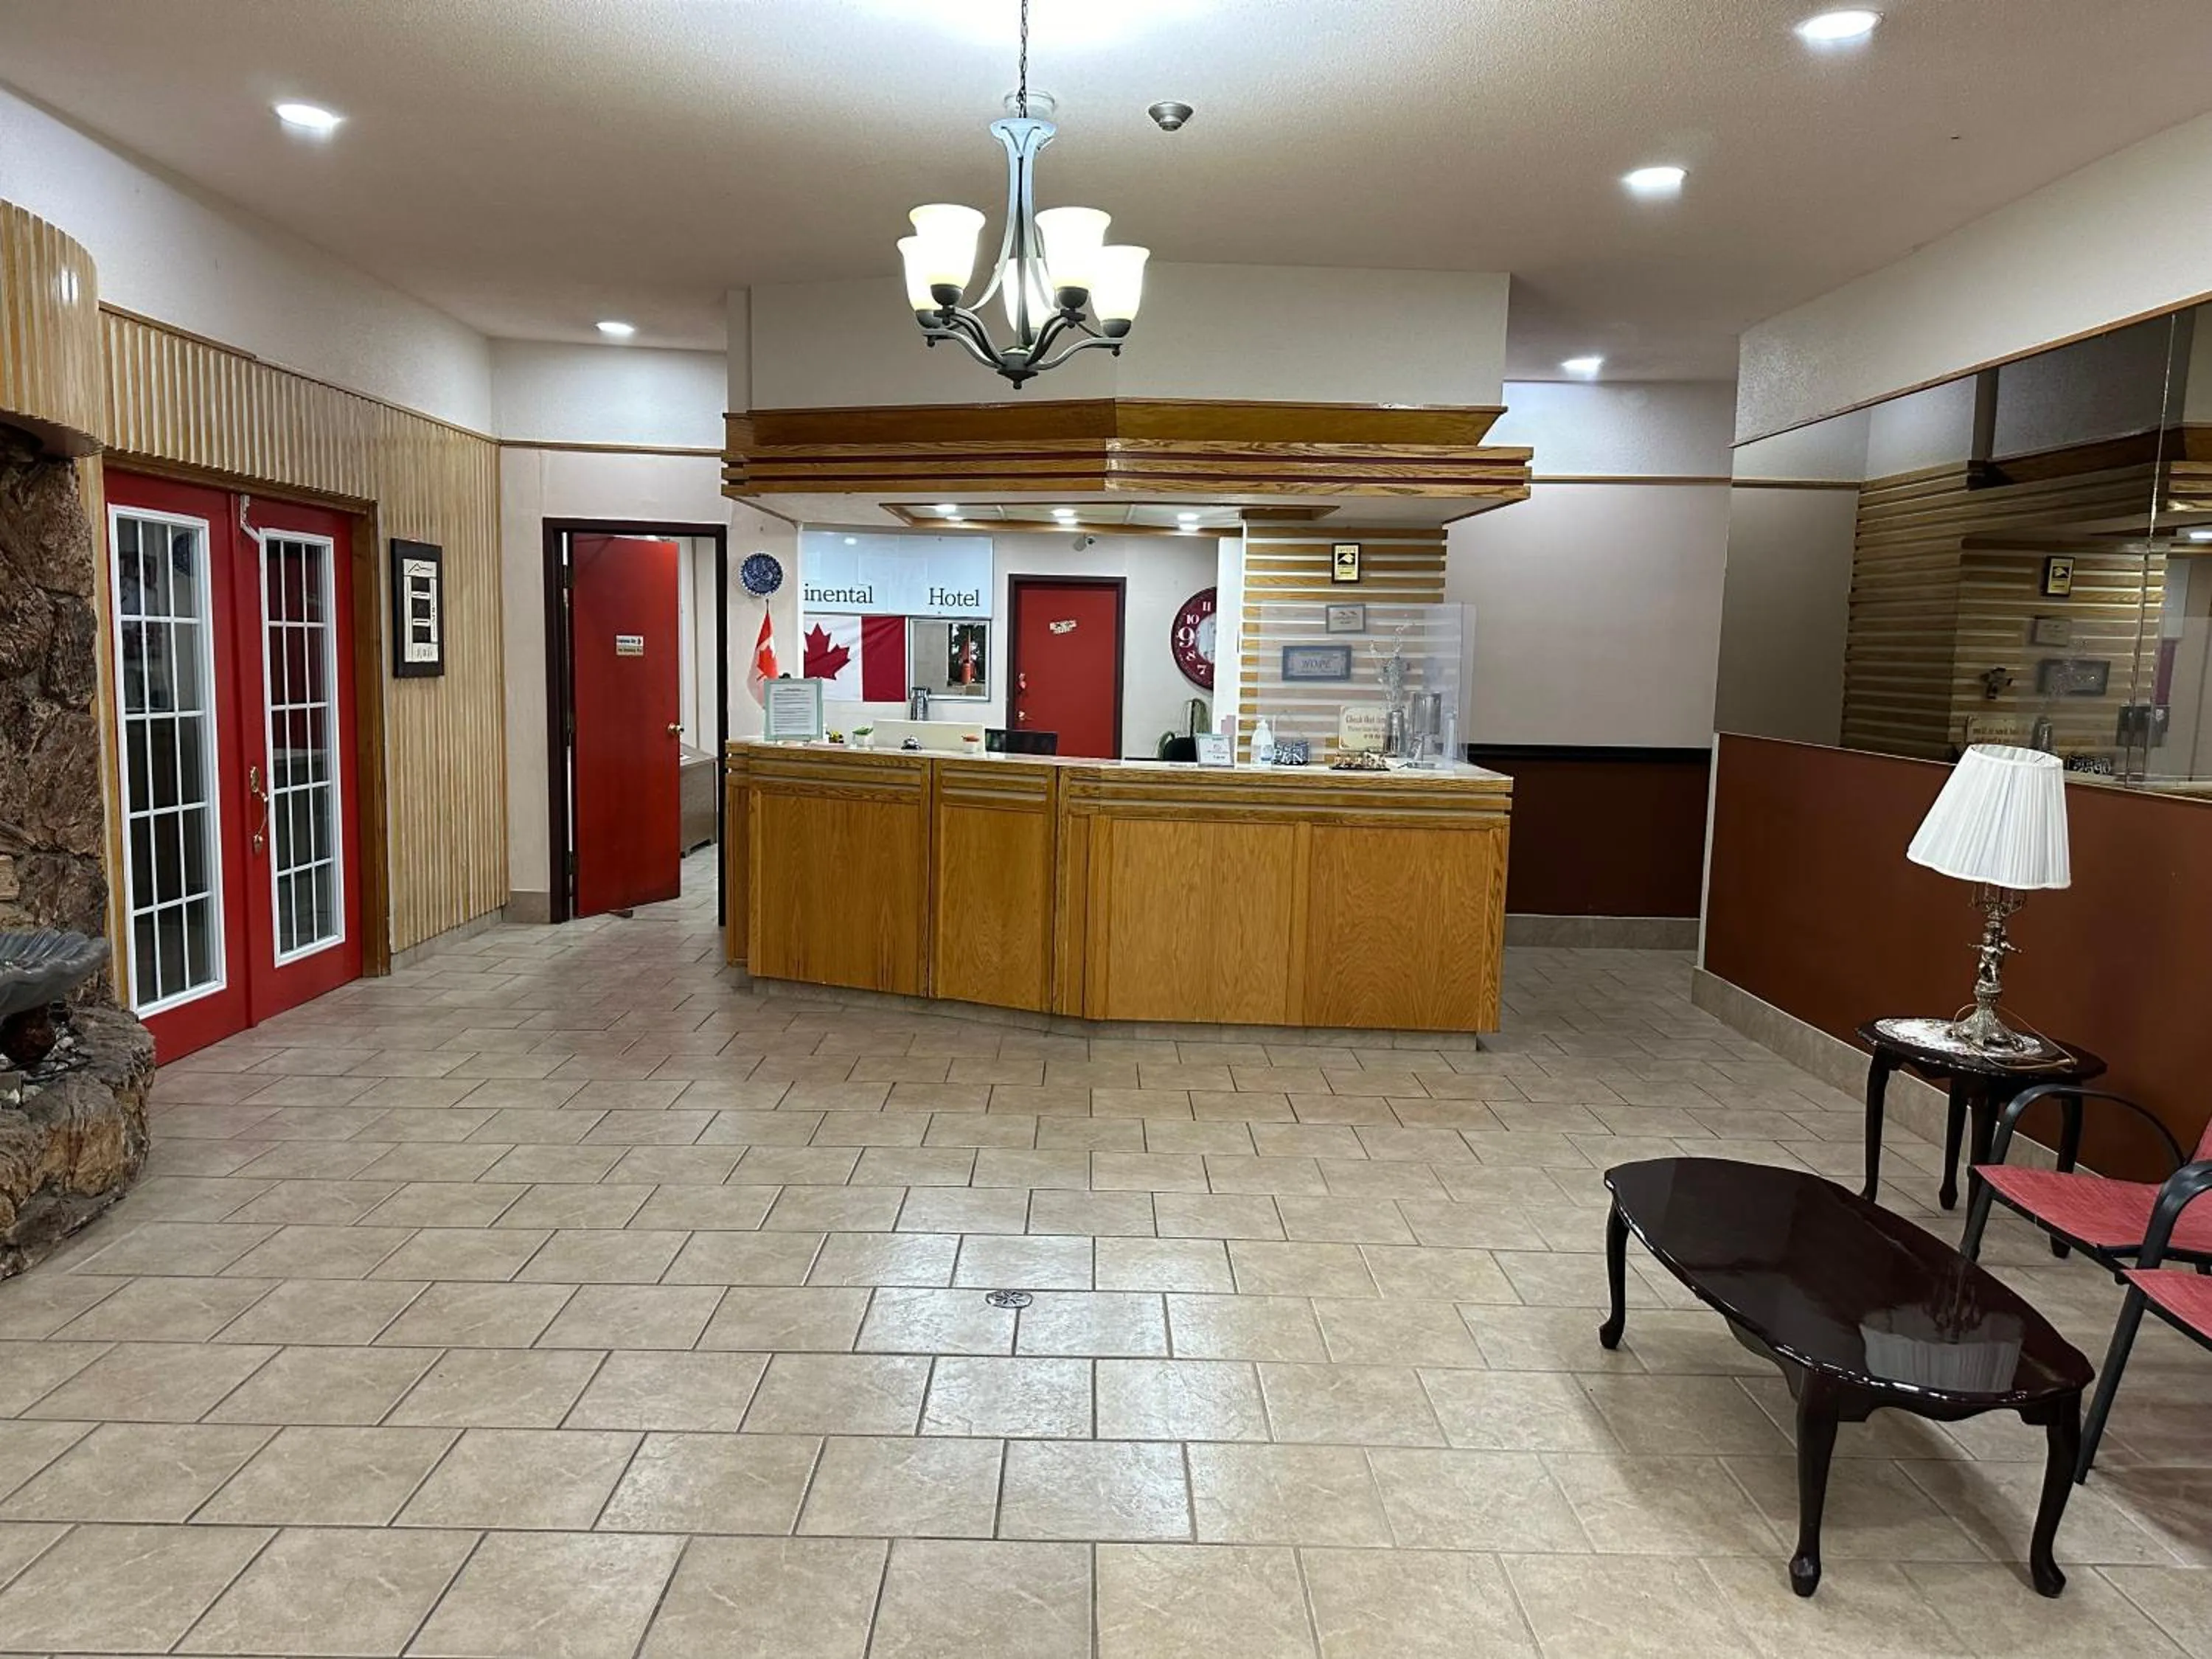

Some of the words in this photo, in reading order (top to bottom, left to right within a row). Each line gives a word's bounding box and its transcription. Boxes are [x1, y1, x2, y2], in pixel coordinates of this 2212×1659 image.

[804, 583, 874, 604] inental
[929, 587, 980, 607] Hotel
[1202, 601, 1211, 611] 11
[1186, 613, 1200, 625] 10
[1178, 626, 1194, 648] 9
[1186, 650, 1196, 661] 8
[1197, 664, 1207, 675] 7
